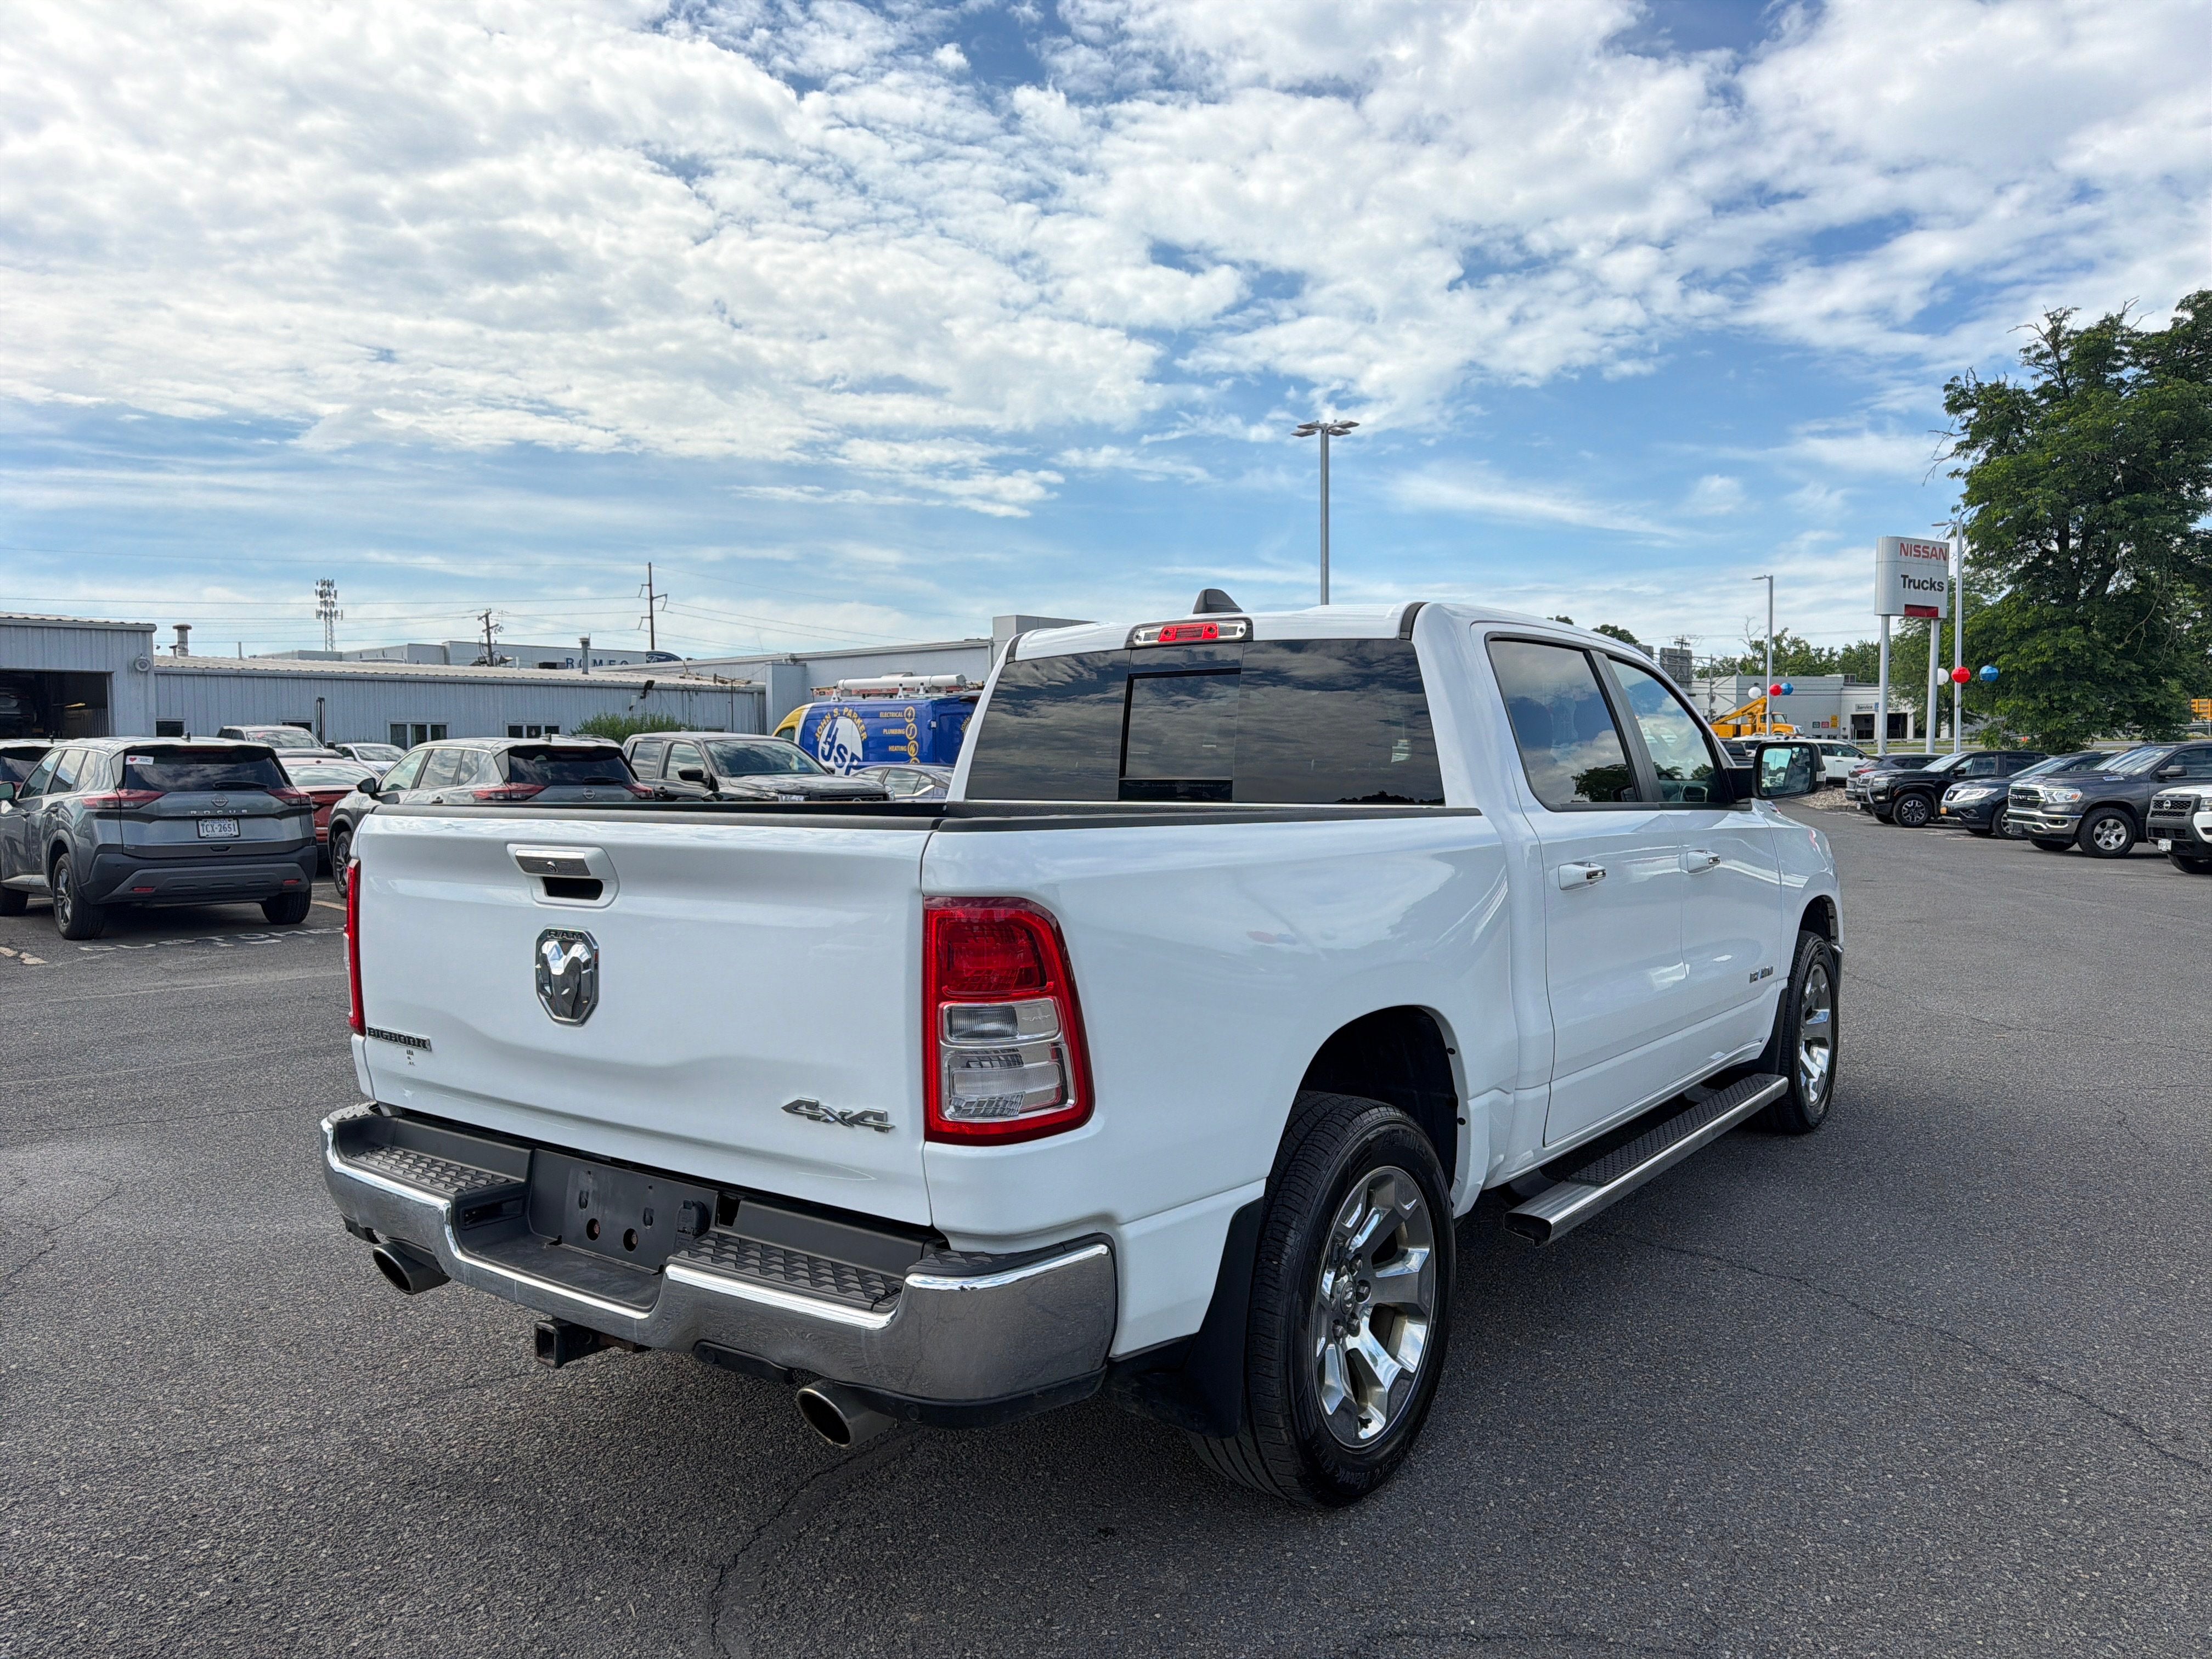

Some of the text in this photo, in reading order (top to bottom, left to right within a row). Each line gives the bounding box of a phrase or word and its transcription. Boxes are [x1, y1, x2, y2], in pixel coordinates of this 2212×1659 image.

[1899, 542, 1947, 561] NISSAN
[1900, 574, 1944, 592] Trucks
[815, 706, 867, 742] JOHN S. PARKER
[201, 823, 236, 833] TCX-2651
[78, 927, 345, 951] CUSTOME
[547, 931, 583, 941] RAM
